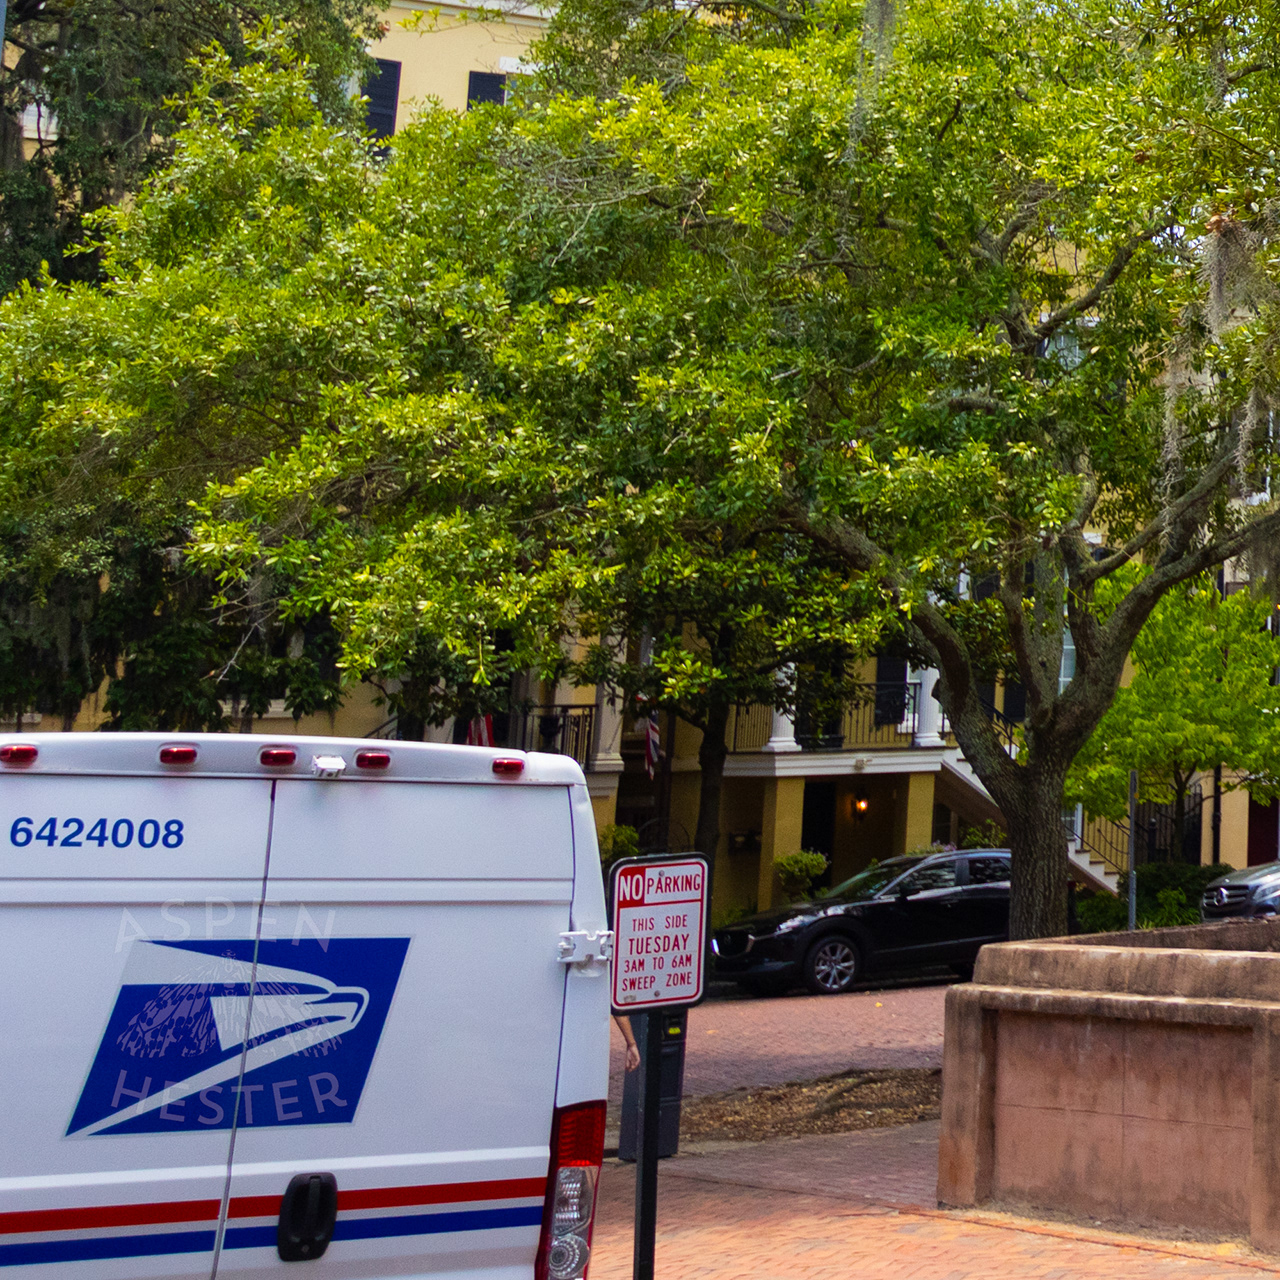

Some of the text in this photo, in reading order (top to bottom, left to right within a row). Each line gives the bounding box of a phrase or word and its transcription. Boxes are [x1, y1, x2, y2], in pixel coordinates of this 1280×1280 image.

[10, 816, 184, 849] 6424008
[619, 873, 701, 902] NO PARKING
[632, 914, 688, 932] THIS SIDE
[629, 933, 690, 955] TUESDAY
[624, 954, 692, 973] 3AM TO 6AM
[622, 972, 692, 992] SWEEP ZONE
